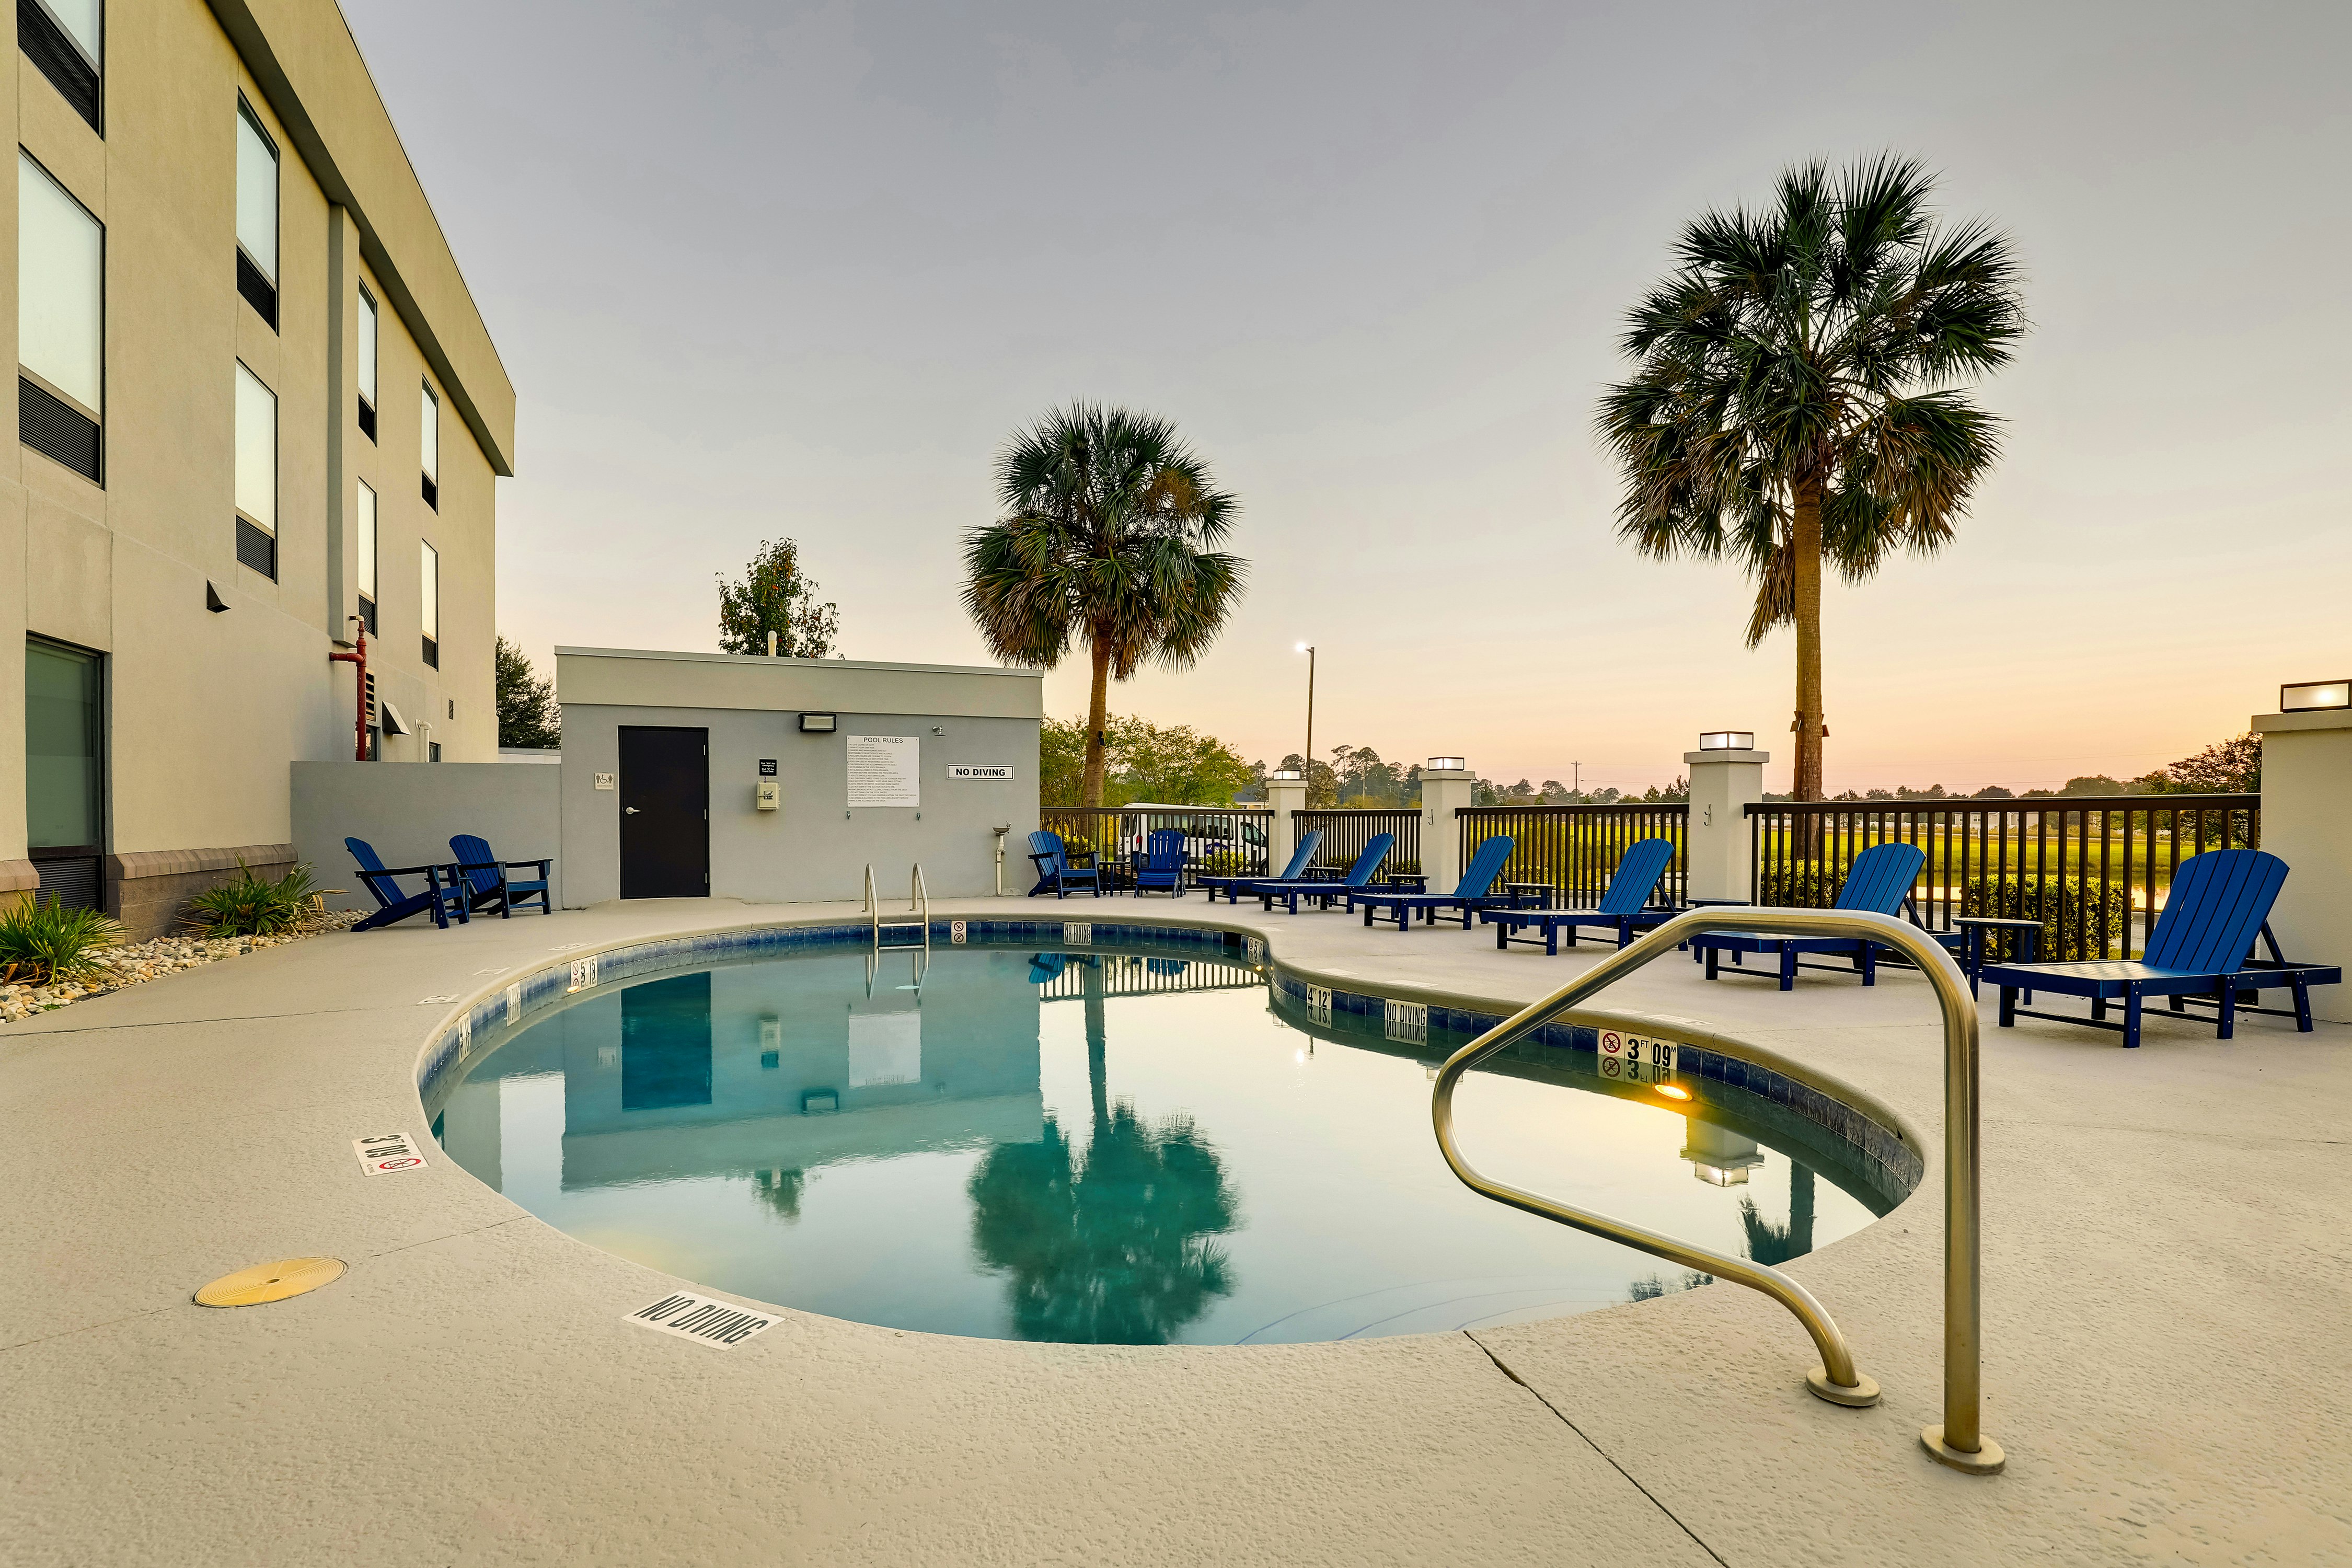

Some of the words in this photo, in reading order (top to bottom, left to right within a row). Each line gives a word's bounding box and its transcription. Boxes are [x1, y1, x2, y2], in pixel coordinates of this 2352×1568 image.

[581, 962, 585, 975] 5
[1308, 987, 1313, 1004] 4
[1387, 1002, 1397, 1021] NO
[1400, 1005, 1425, 1025] DIVING
[1627, 1038, 1639, 1060] 3
[1652, 1043, 1671, 1067] 0.9
[361, 1135, 401, 1144] 3
[633, 1295, 696, 1321] NO
[667, 1304, 768, 1344] DIVING
